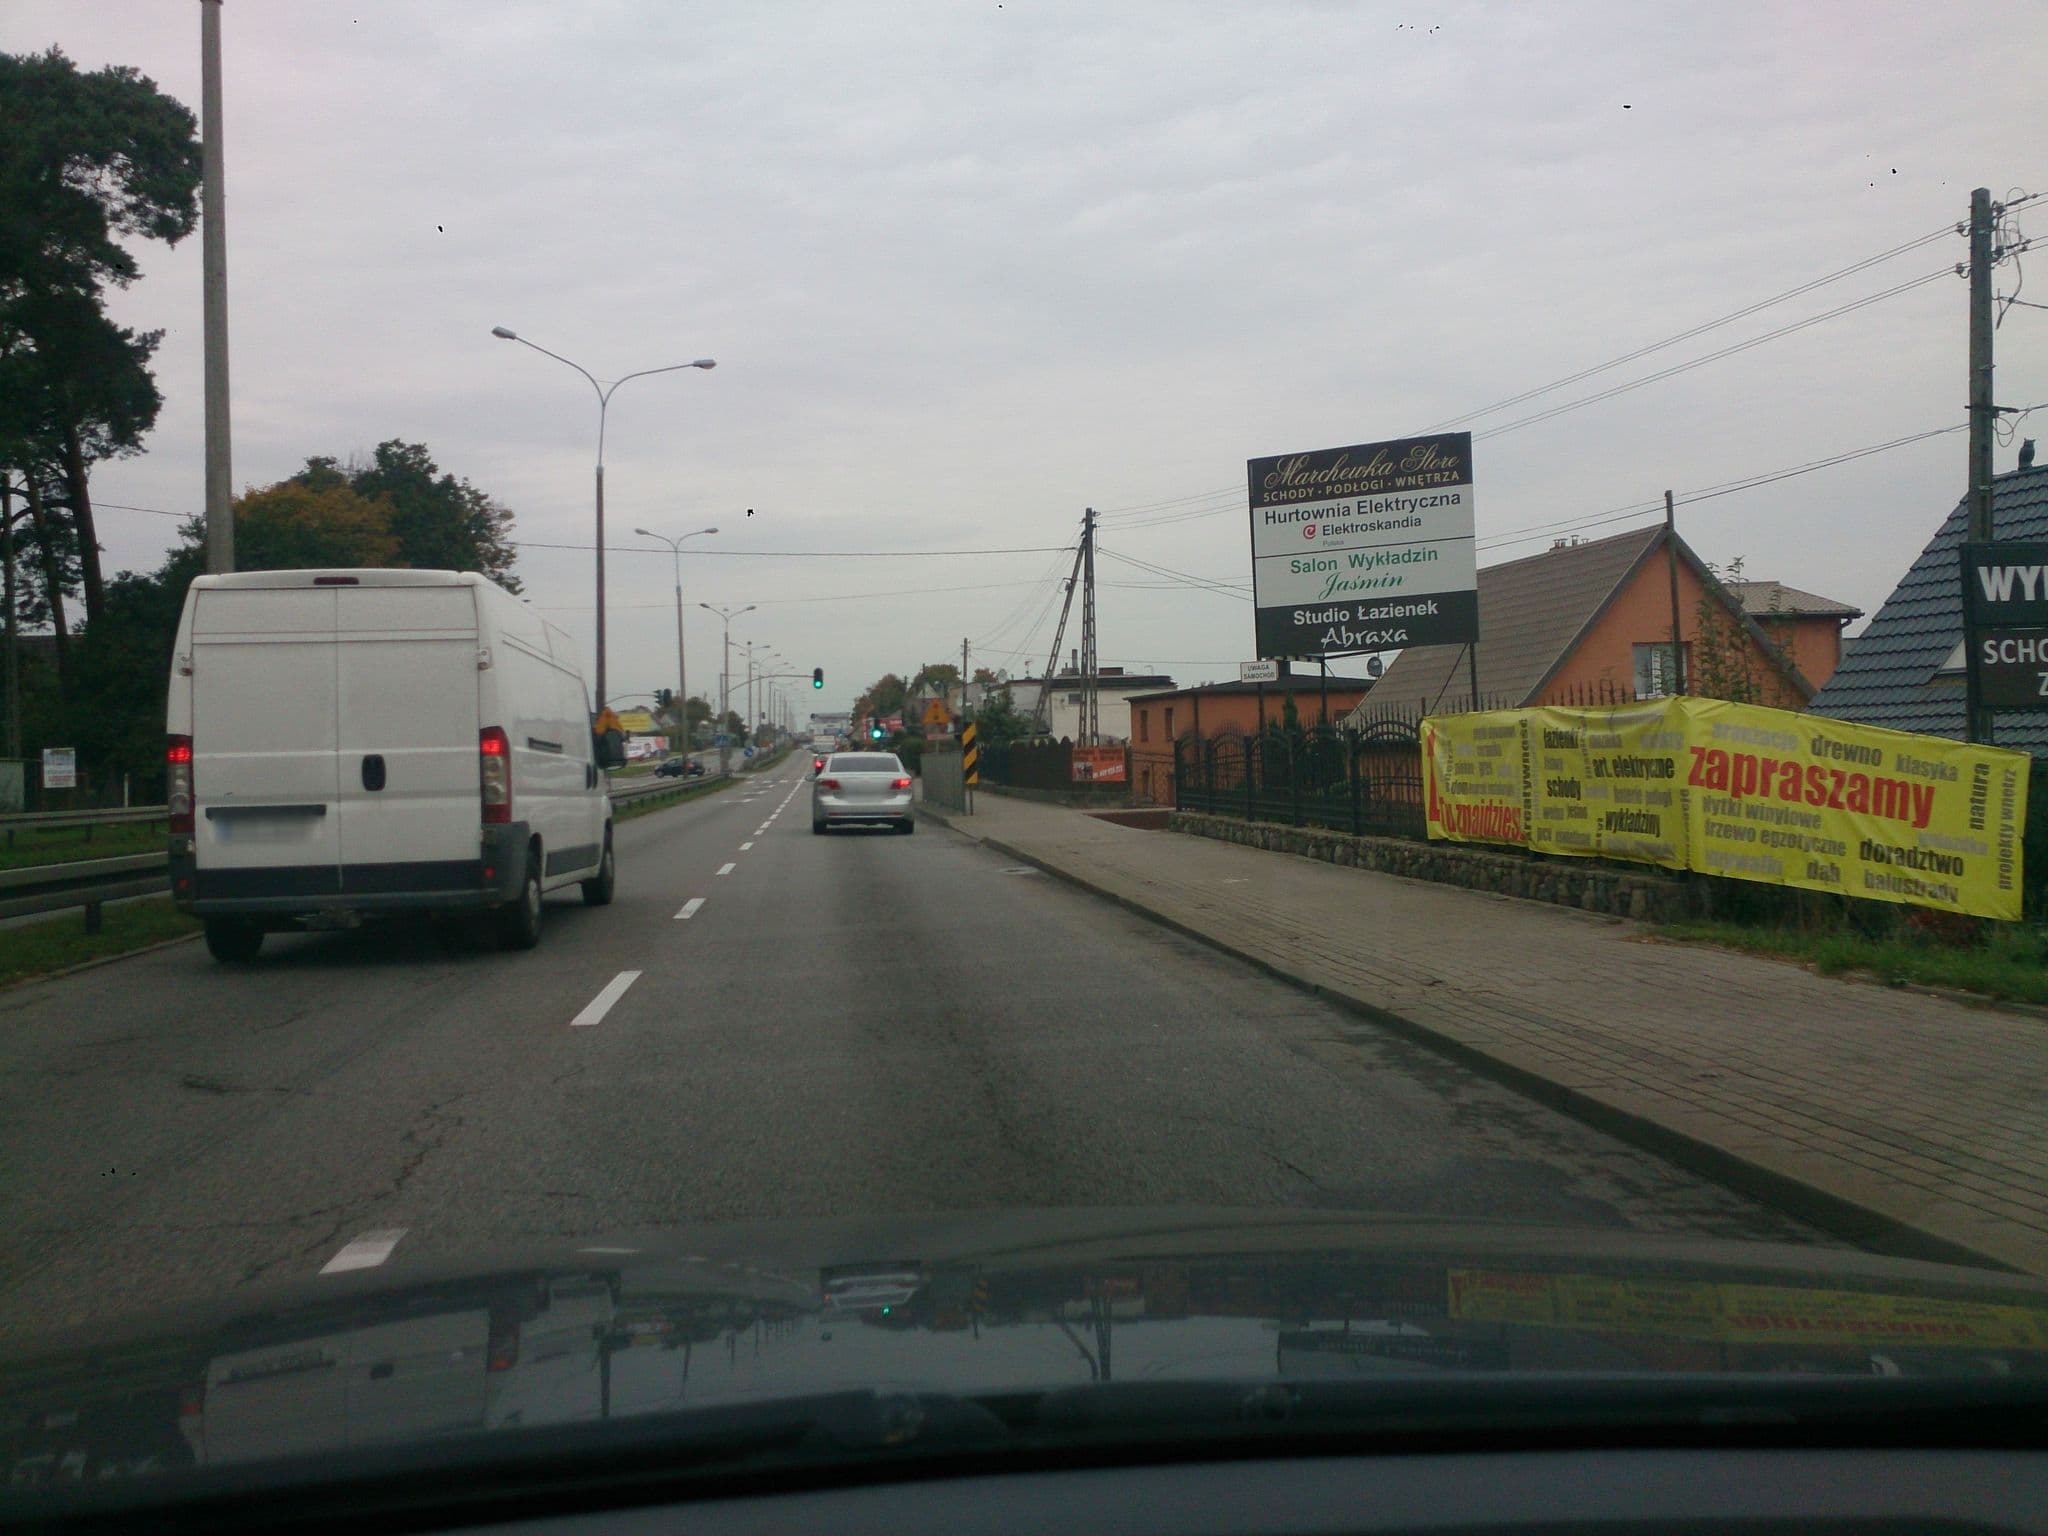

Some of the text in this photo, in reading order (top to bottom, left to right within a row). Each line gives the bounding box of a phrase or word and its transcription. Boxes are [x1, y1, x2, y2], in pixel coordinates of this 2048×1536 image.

[1264, 443, 1459, 489] Marchewka Store
[1263, 470, 1460, 502] SCHODY PODŁOGI WNĘTRZA
[1264, 493, 1461, 525] Hurtownia Elektryczna
[1322, 516, 1421, 536] Elektroskandia
[1290, 547, 1438, 574] Salon Wykładzin
[1318, 571, 1405, 600] Jaśmin
[1977, 565, 2048, 602] WY
[1293, 600, 1438, 625] Studio Łazienek
[1320, 625, 1408, 649] Abraxa
[1612, 755, 1675, 781] elektryczne
[1811, 735, 1958, 782] drewno klasyka
[1547, 776, 1581, 800] schody
[1688, 746, 1936, 829] zapraszamy
[1969, 763, 1990, 831] natura
[1606, 808, 1660, 838] wykładziny
[1745, 802, 1822, 829] winylowe
[1760, 829, 1847, 857] egzotyczne
[1859, 837, 1964, 877] doradztwo
